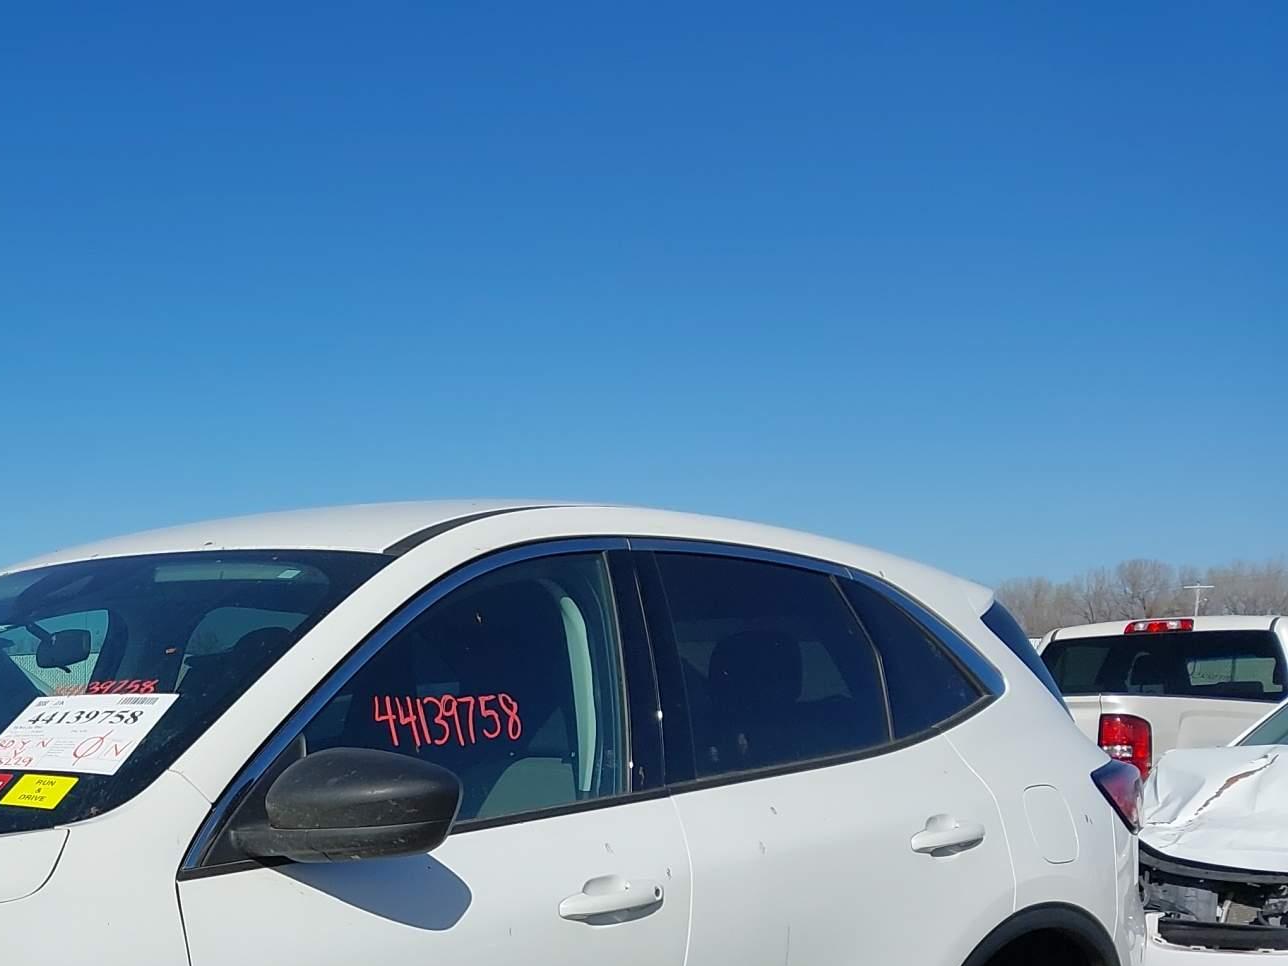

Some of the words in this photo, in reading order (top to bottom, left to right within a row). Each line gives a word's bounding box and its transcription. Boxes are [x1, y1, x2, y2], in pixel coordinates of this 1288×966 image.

[27, 710, 144, 725] 44139758
[373, 693, 523, 747] 44139758
[35, 779, 56, 787] RUN
[18, 794, 48, 802] DRIVE
